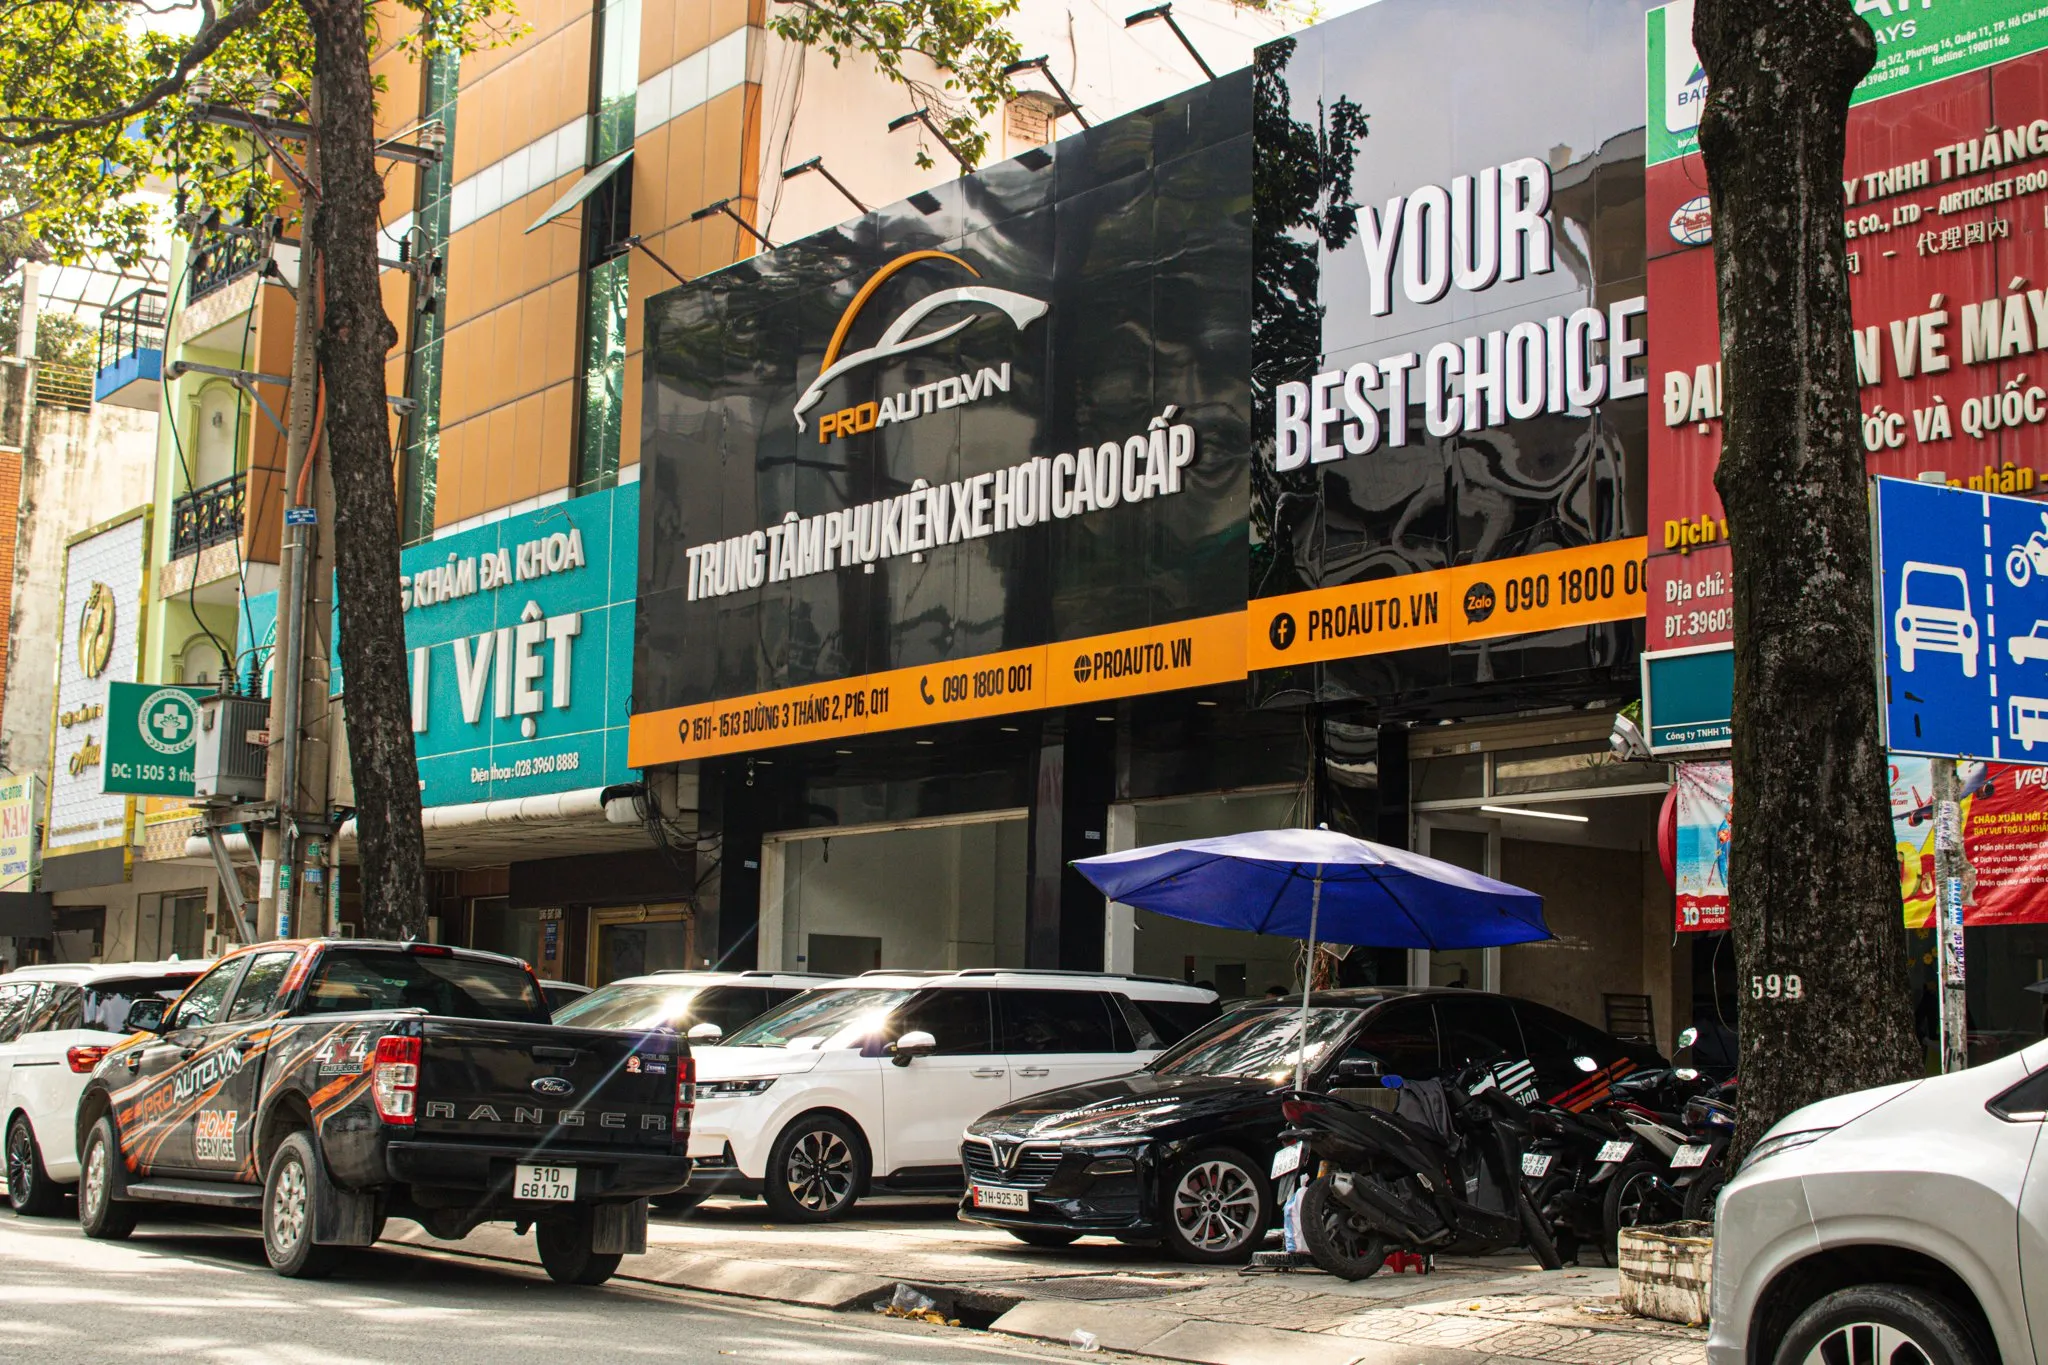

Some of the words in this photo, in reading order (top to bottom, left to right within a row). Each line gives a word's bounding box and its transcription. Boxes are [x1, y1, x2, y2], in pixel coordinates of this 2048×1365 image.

[1993, 20, 2007, 33] TP.
[1932, 48, 1966, 66] Hotline:
[1864, 158, 1930, 200] TNHH
[1934, 118, 2048, 181] THĂNG
[1893, 203, 1922, 227] LTD
[1938, 178, 2014, 216] AIRTICKET
[1355, 157, 1555, 318] YOUR
[1889, 292, 1950, 380] VÉ
[1961, 274, 2048, 366] MÁY
[819, 361, 1011, 444] PROAUTO.VN
[1276, 351, 1421, 473] BEST
[1425, 295, 1647, 438] CHOICE
[1861, 403, 1906, 452] ỚC
[1913, 394, 1953, 444] VÀ
[1961, 372, 2048, 440] QUỐC
[1968, 460, 2035, 494] nhân
[686, 530, 767, 602] TRUNG
[766, 510, 826, 584] TÂM
[823, 501, 882, 575] PHỤ
[879, 478, 952, 564] KIỆN
[949, 470, 996, 544] XE
[995, 454, 1052, 531] HƠI
[1051, 440, 1122, 521] CAO
[1120, 404, 1197, 505] CẤP
[1664, 513, 1717, 556] Dịch
[413, 552, 478, 608] KHÁM
[479, 547, 514, 591] ĐA
[516, 527, 586, 582] KHOA
[1308, 591, 1439, 642] PROAUTO.VN
[1467, 595, 1493, 611] Zalo
[1505, 574, 1550, 613] 090
[1557, 564, 1615, 606] 1800
[1665, 578, 1693, 608] Địa
[1695, 570, 1725, 598] chỉ:
[453, 600, 582, 739] VIỆT
[942, 673, 968, 704] 090
[972, 666, 1005, 700] 1800
[1008, 663, 1033, 694] 001
[743, 701, 779, 735] ĐƯỜNG
[781, 703, 790, 728] 3
[792, 693, 830, 727] THÁNG
[832, 695, 843, 723] 2,
[844, 690, 869, 720] P16,
[870, 686, 889, 715] Q11
[1665, 729, 1686, 742] Công
[1687, 730, 1696, 741] ty
[1697, 727, 1720, 738] TNHH
[111, 763, 132, 779] ĐC:
[135, 764, 165, 781] 1505
[168, 766, 176, 782] 3
[470, 765, 491, 786] Điện
[532, 754, 555, 775] 3960
[556, 751, 579, 773] 8888
[3, 803, 29, 839] NAM
[1973, 813, 1997, 825] CHÀO
[1998, 811, 2023, 823] XUÂN
[1682, 906, 1700, 926] 10
[1700, 904, 1726, 918] TRIỆU
[1751, 973, 1802, 999] 599
[143, 1046, 242, 1125] PROAUTO.VN
[196, 1110, 238, 1138] HOME
[425, 1101, 667, 1131] RANGER
[195, 1138, 237, 1161] SERVICE
[520, 1184, 569, 1200] 681.70
[533, 1168, 560, 1183] 51D
